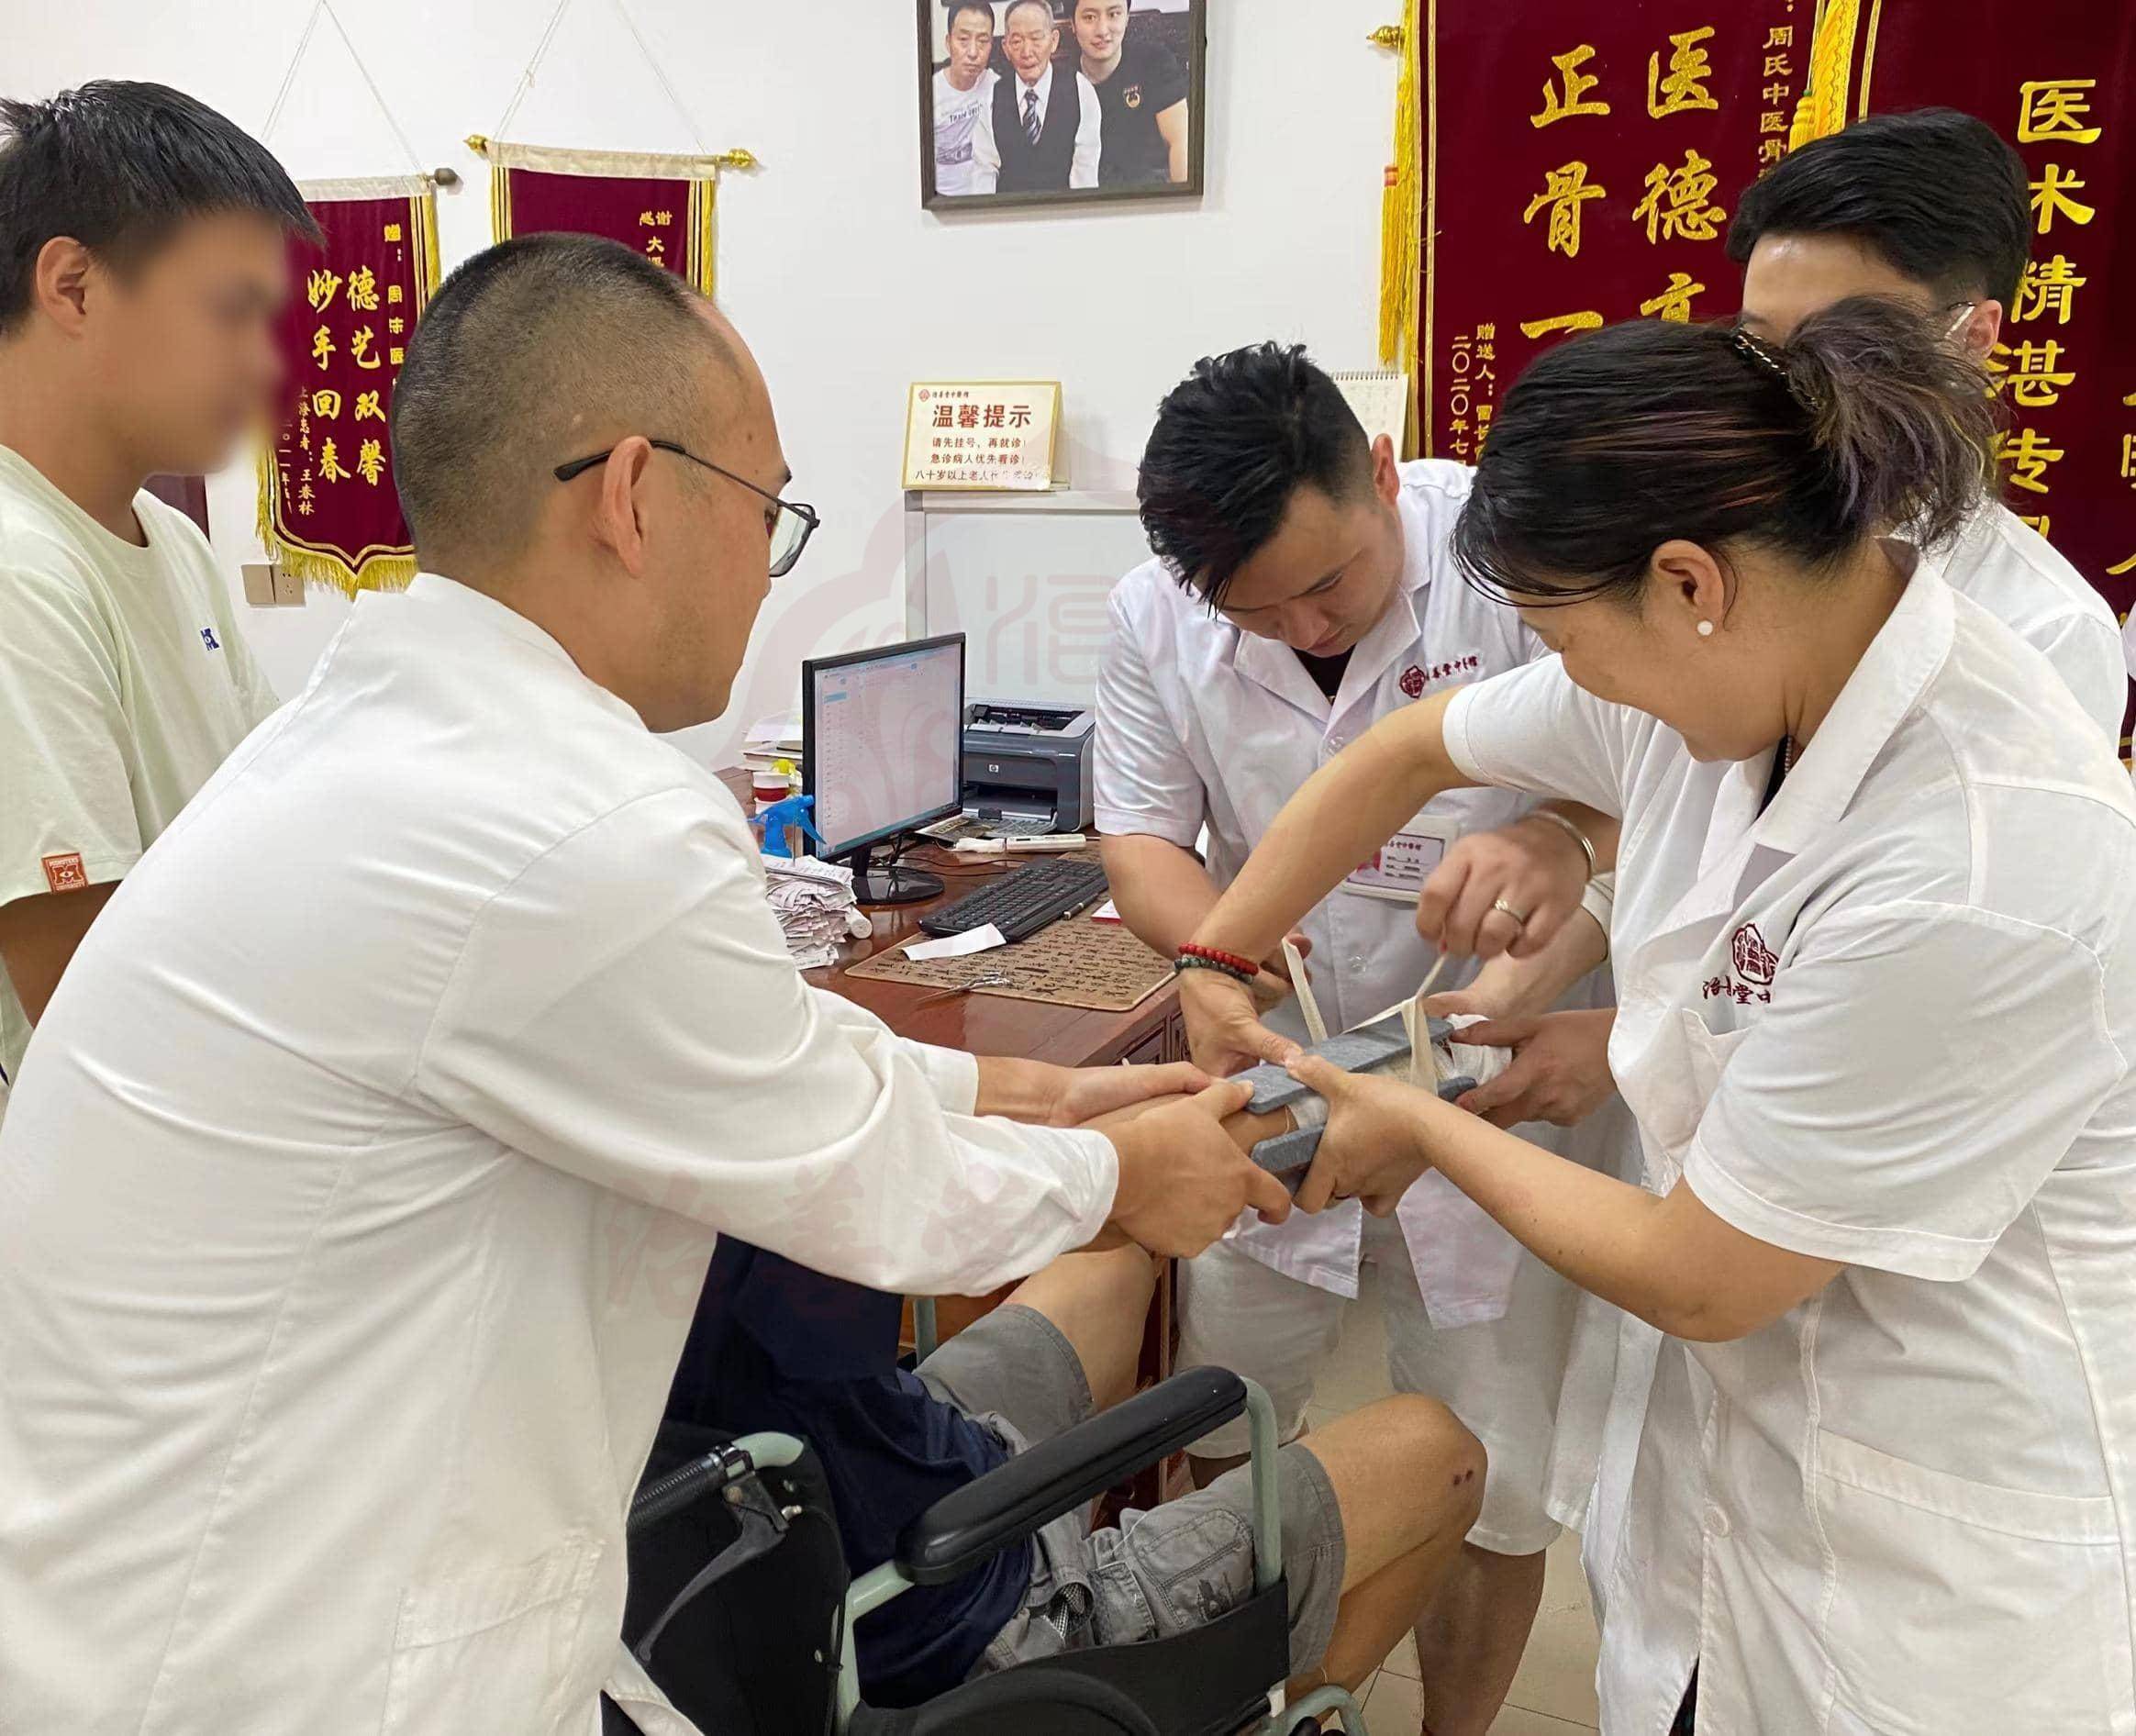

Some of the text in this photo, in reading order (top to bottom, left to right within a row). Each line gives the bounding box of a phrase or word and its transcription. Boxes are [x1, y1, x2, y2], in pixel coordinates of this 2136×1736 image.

[306, 269, 352, 484] 妙手回春
[346, 264, 387, 486] 德艺双馨
[931, 404, 1032, 428] 温馨提示
[1449, 335, 1472, 466] 二〇二〇年七
[1983, 79, 2103, 539] 医术精湛专
